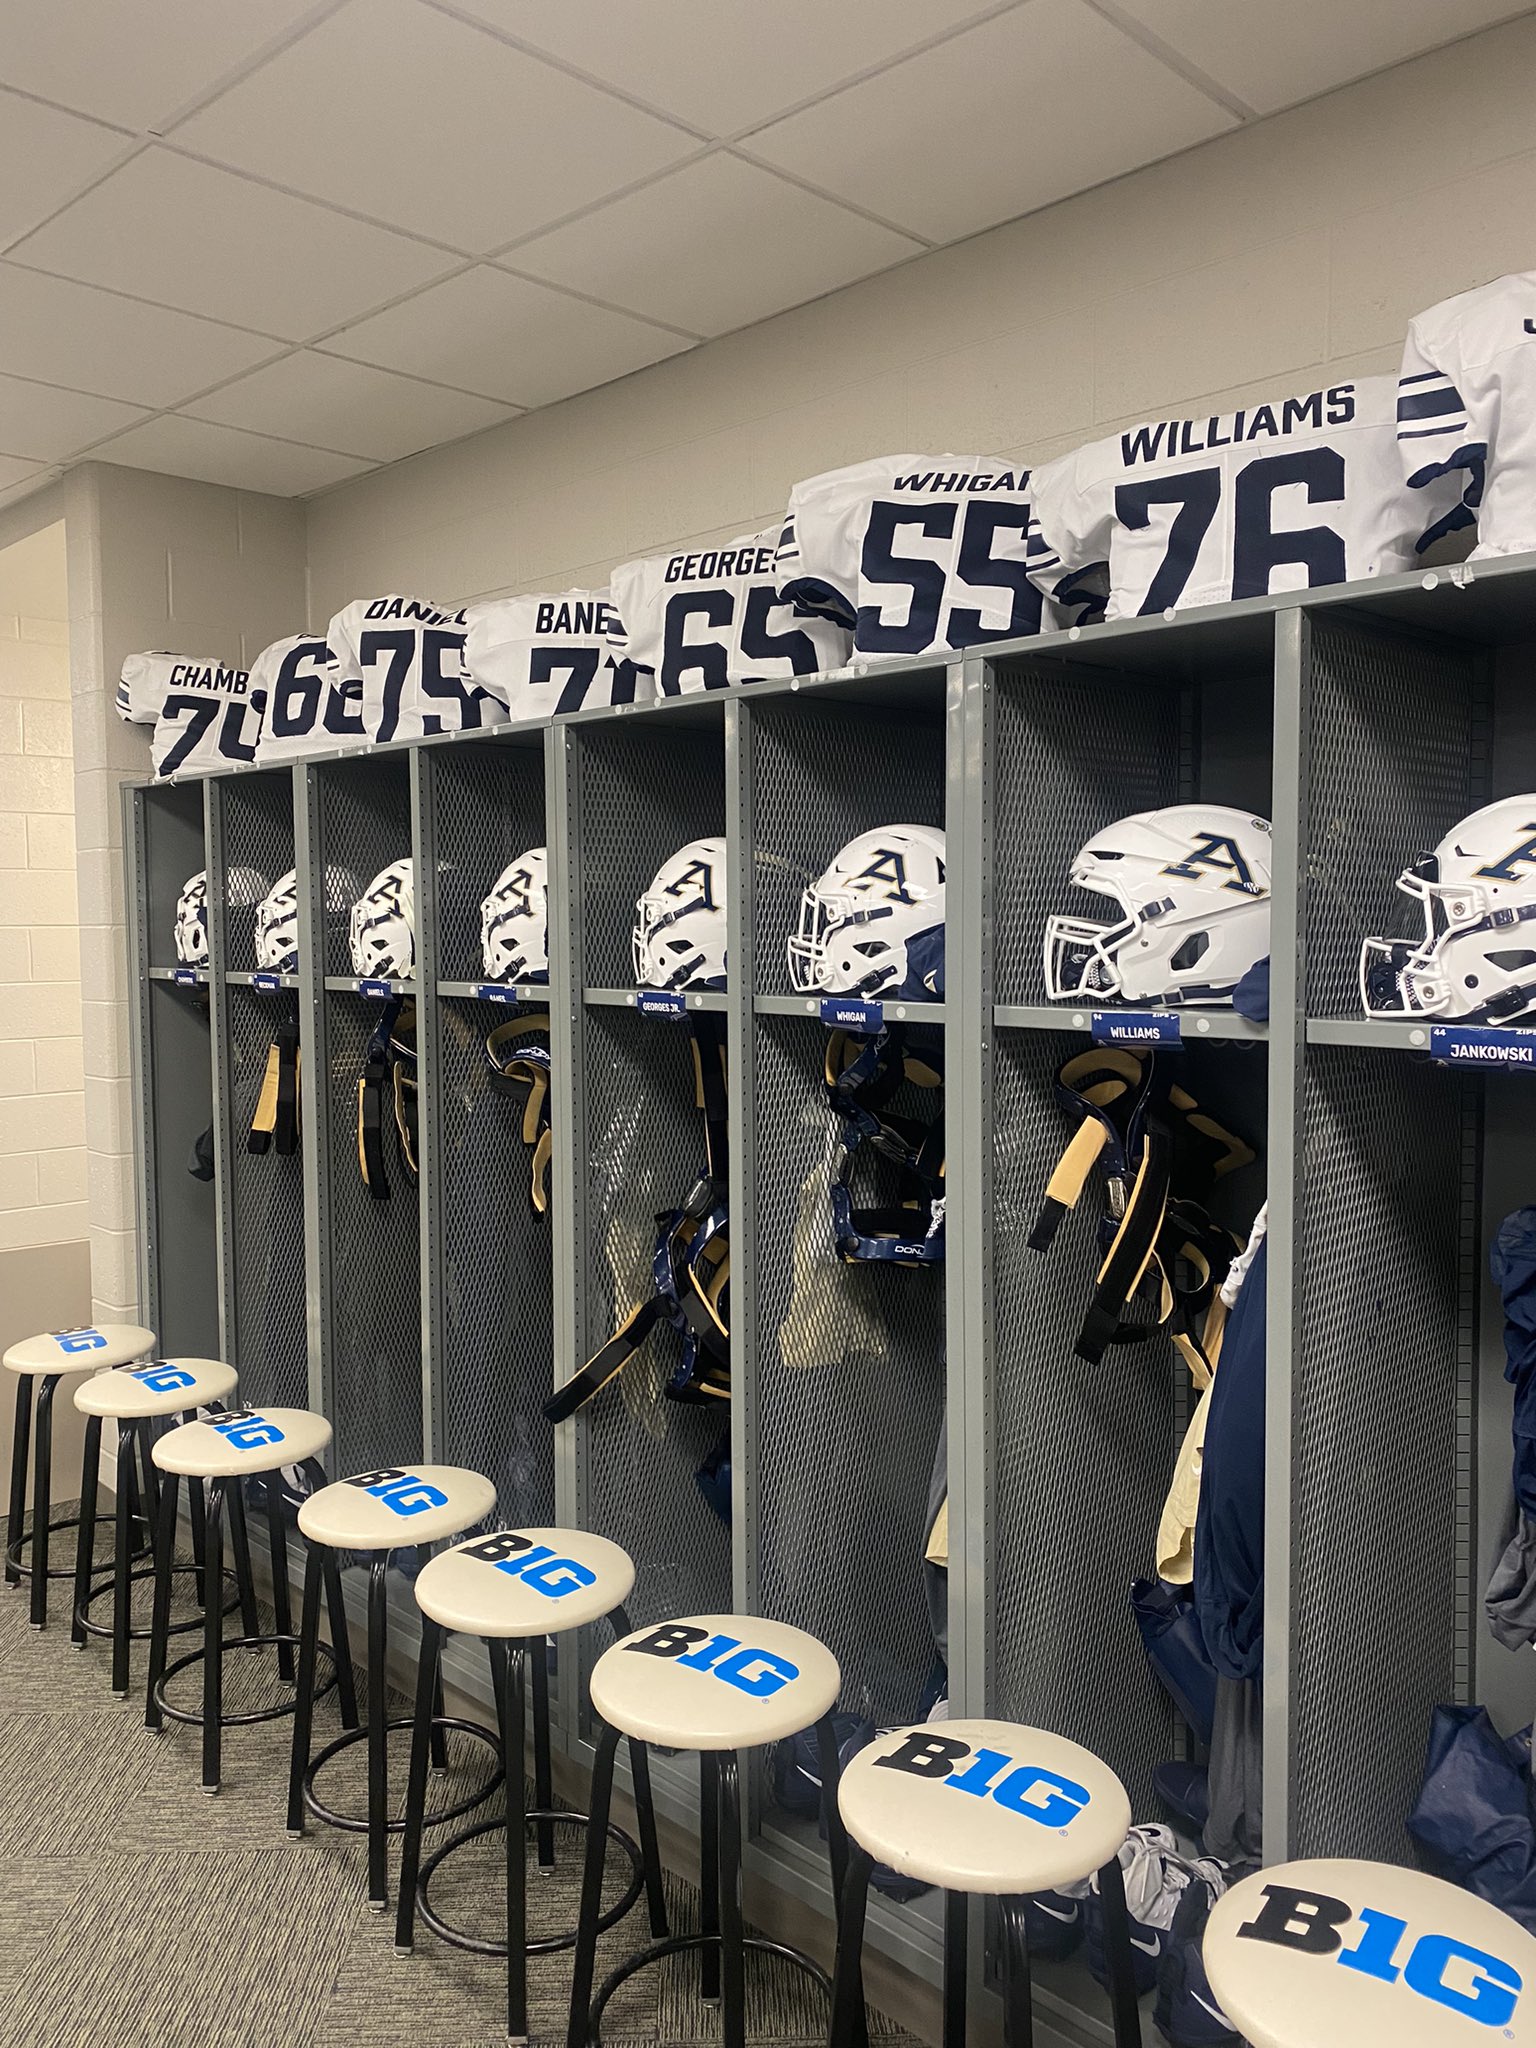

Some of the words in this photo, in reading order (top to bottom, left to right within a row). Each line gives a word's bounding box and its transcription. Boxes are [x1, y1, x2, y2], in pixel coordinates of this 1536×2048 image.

[1121, 384, 1355, 467] WILLIAMS
[1115, 446, 1347, 617] 76
[664, 547, 778, 584] GEORGE
[854, 499, 1044, 655] 55
[661, 586, 819, 697] 65
[360, 629, 482, 744] 75
[662, 859, 719, 912] A
[842, 848, 919, 906] A
[642, 1001, 670, 1012] GEORGES
[836, 1011, 867, 1023] WHIGAN
[1110, 1026, 1161, 1040] WILLIAMS
[1433, 1028, 1447, 1037] 44
[1450, 1044, 1533, 1062] JANKOWSKI
